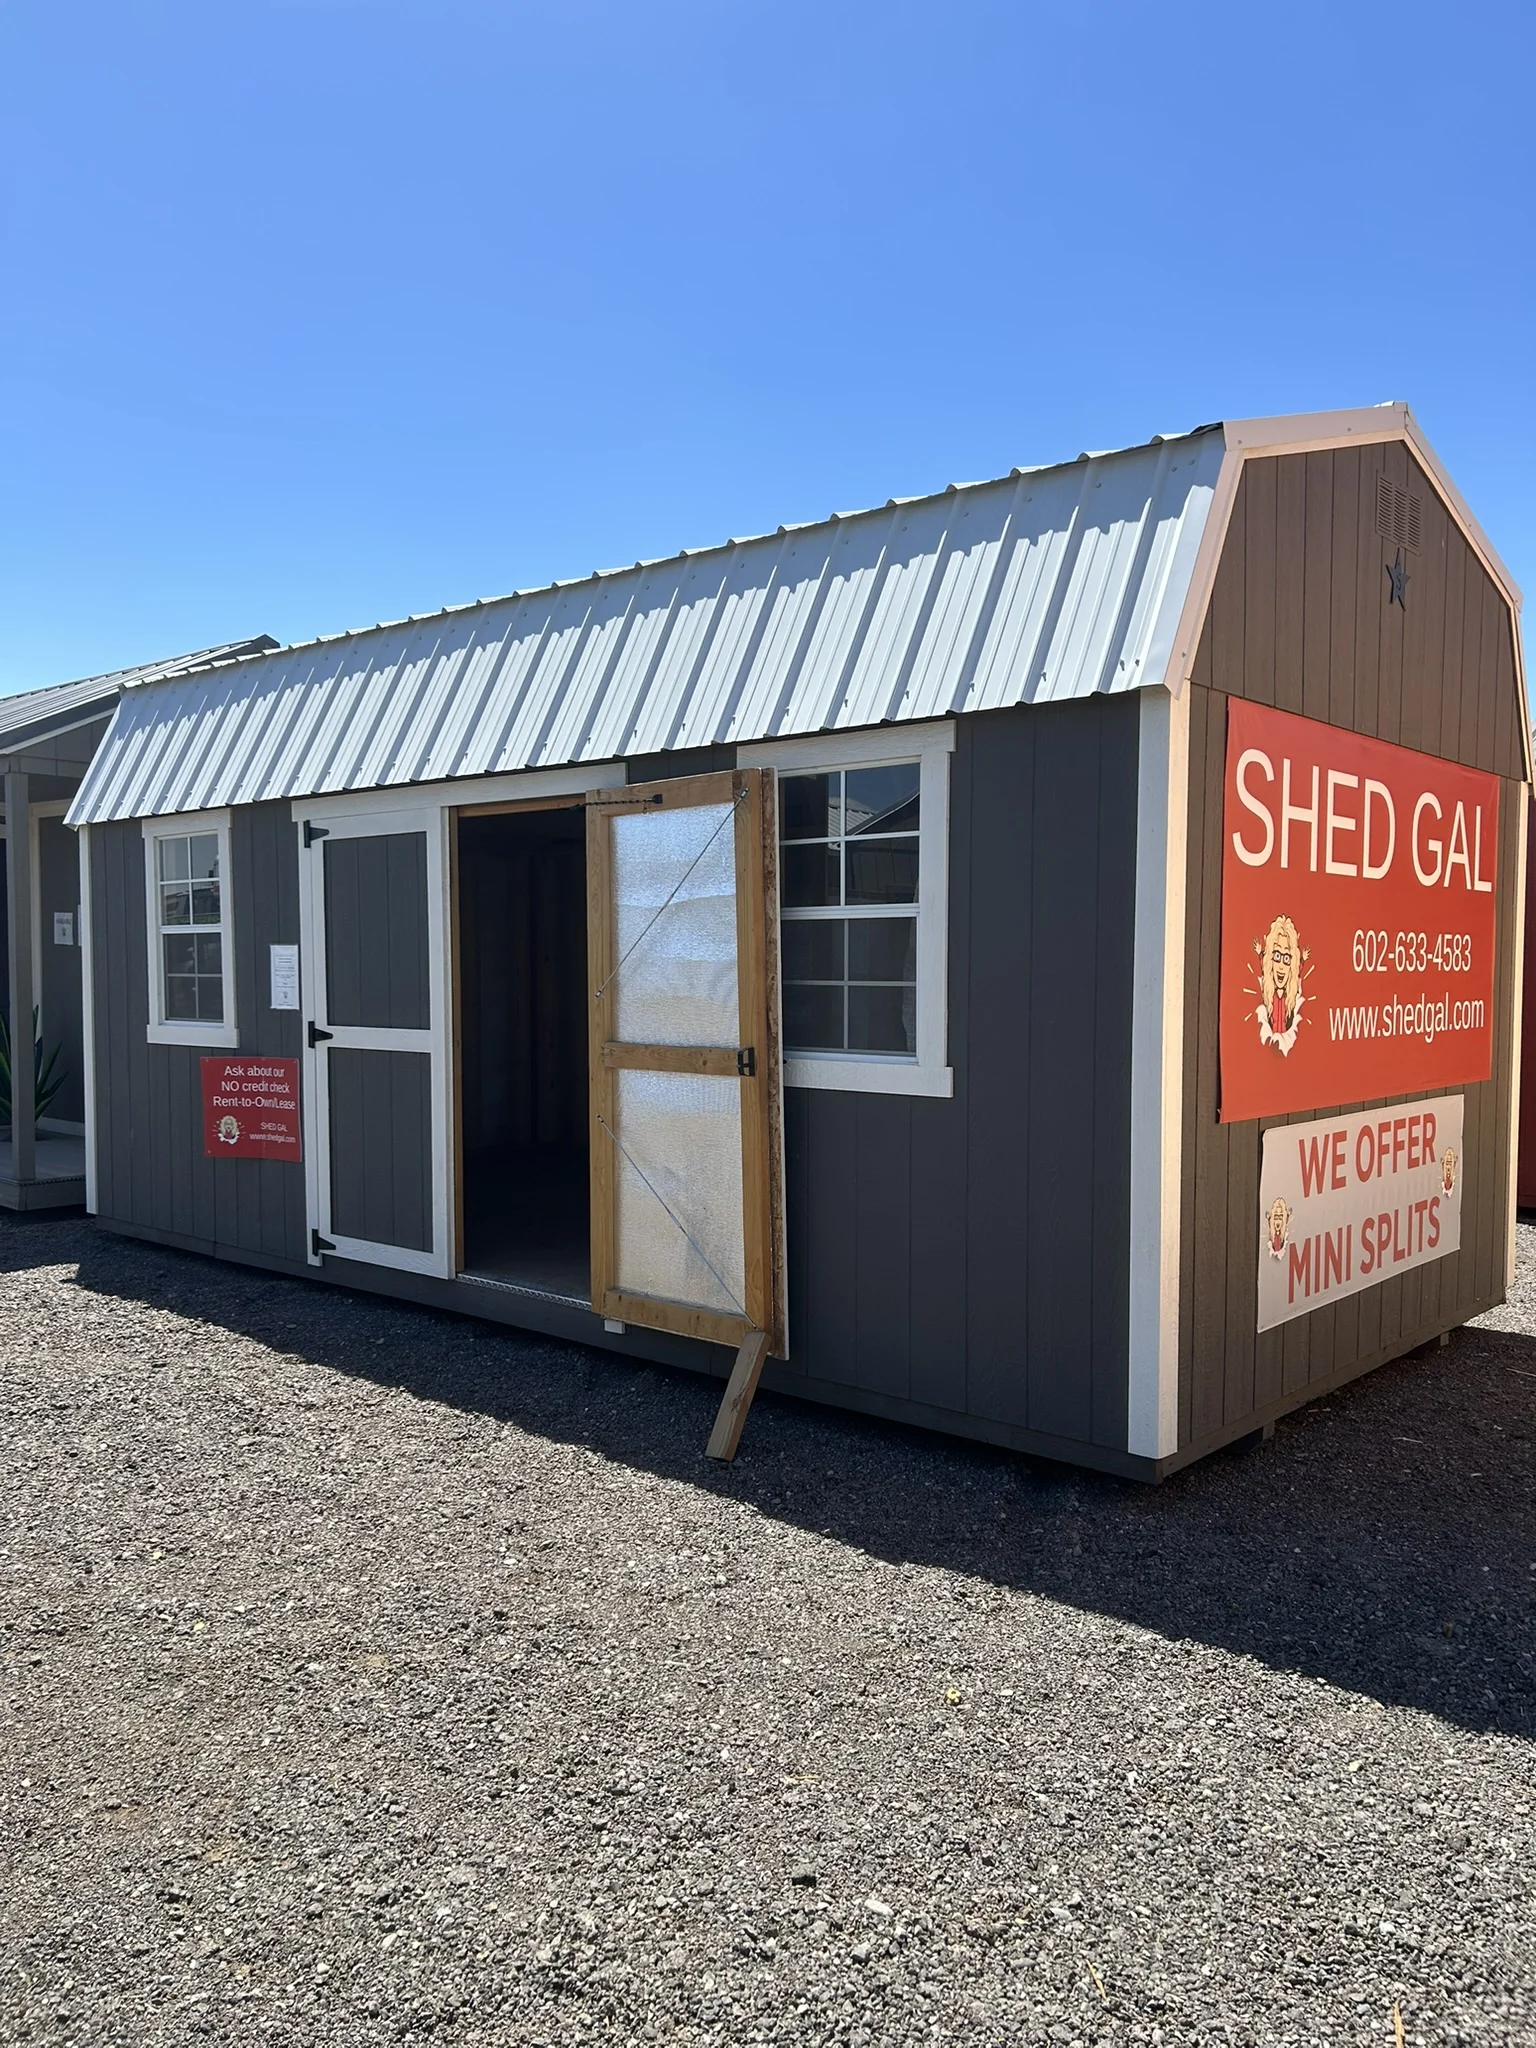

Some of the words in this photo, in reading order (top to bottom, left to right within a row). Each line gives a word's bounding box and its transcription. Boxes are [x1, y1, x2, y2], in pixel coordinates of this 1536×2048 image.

[1232, 748, 1396, 880] SHED
[1411, 791, 1492, 893] GAL
[1352, 928, 1472, 973] 602-633-4583
[1329, 992, 1485, 1043] www.shedgal.com
[221, 1081, 240, 1092] NO
[242, 1081, 269, 1092] credit
[270, 1082, 290, 1094] check
[224, 1065, 245, 1076] Ask
[247, 1065, 272, 1077] about
[273, 1068, 285, 1077] our
[213, 1096, 296, 1110] Rent-to-Own/Lease
[260, 1122, 277, 1131] SHED
[277, 1123, 288, 1132] GAL
[1299, 1130, 1347, 1198] WE
[1355, 1112, 1436, 1182] OFFER
[1288, 1224, 1352, 1304] MINI
[1360, 1196, 1441, 1275] SPLITS
